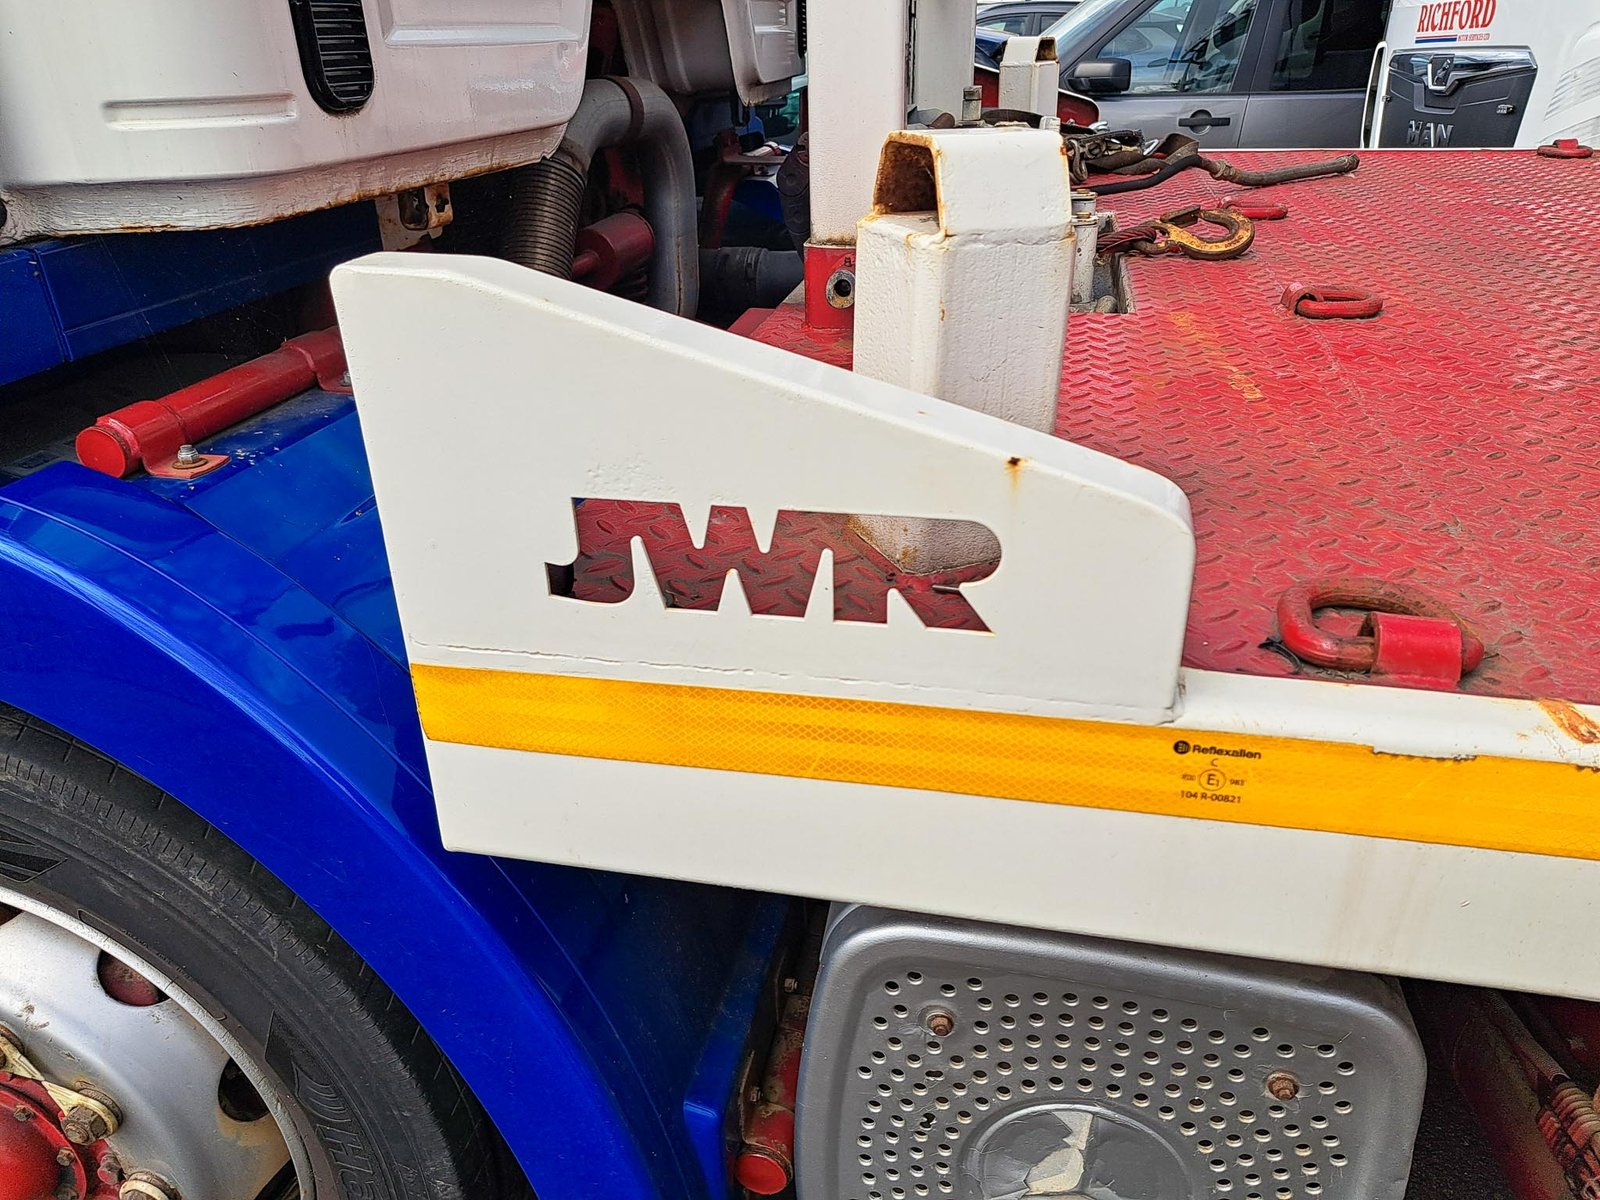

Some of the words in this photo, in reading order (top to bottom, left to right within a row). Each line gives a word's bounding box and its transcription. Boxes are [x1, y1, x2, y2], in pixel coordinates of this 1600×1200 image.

[1416, 0, 1497, 32] RICHFORD
[544, 496, 1002, 636] JWR
[1180, 790, 1198, 800] 104
